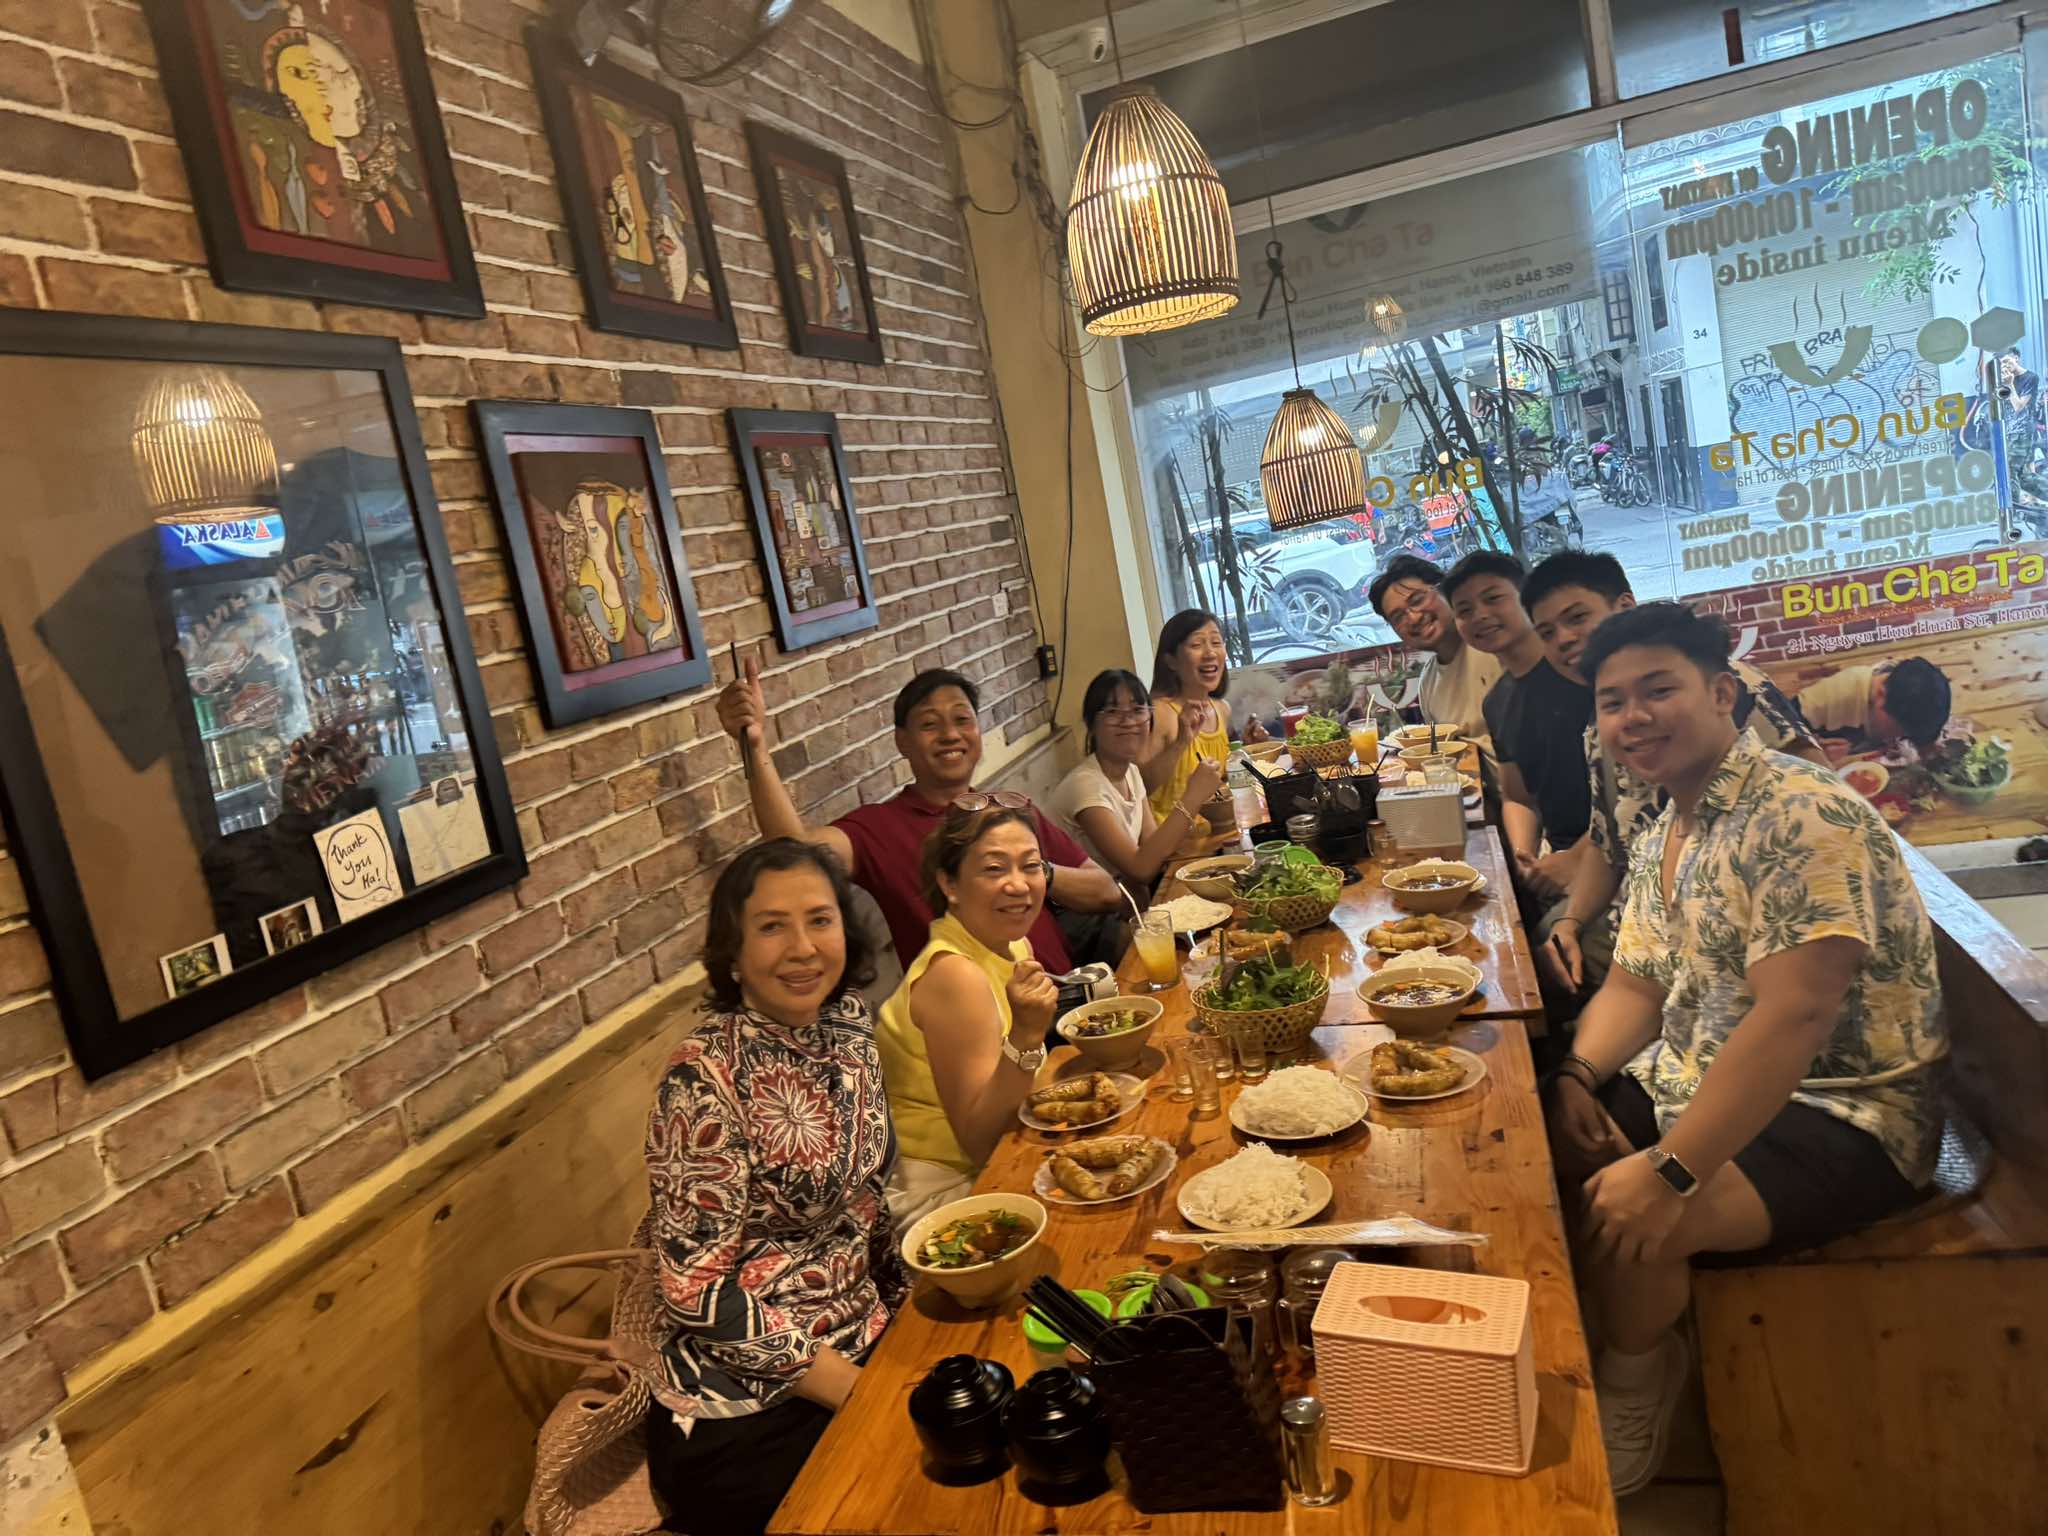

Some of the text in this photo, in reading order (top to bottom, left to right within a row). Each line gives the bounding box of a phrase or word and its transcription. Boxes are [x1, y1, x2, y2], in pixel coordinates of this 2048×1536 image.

[1322, 234, 1388, 270] Cha
[1392, 219, 1436, 251] Ta
[1470, 255, 1533, 278] Vietnam
[1546, 261, 1575, 279] 389
[1693, 327, 1708, 340] 34
[1781, 581, 1870, 620] Bun
[1883, 563, 1978, 604] Cha
[1986, 549, 2046, 588] Ta
[1810, 632, 1874, 653] Nguyen
[331, 832, 368, 865] Thank
